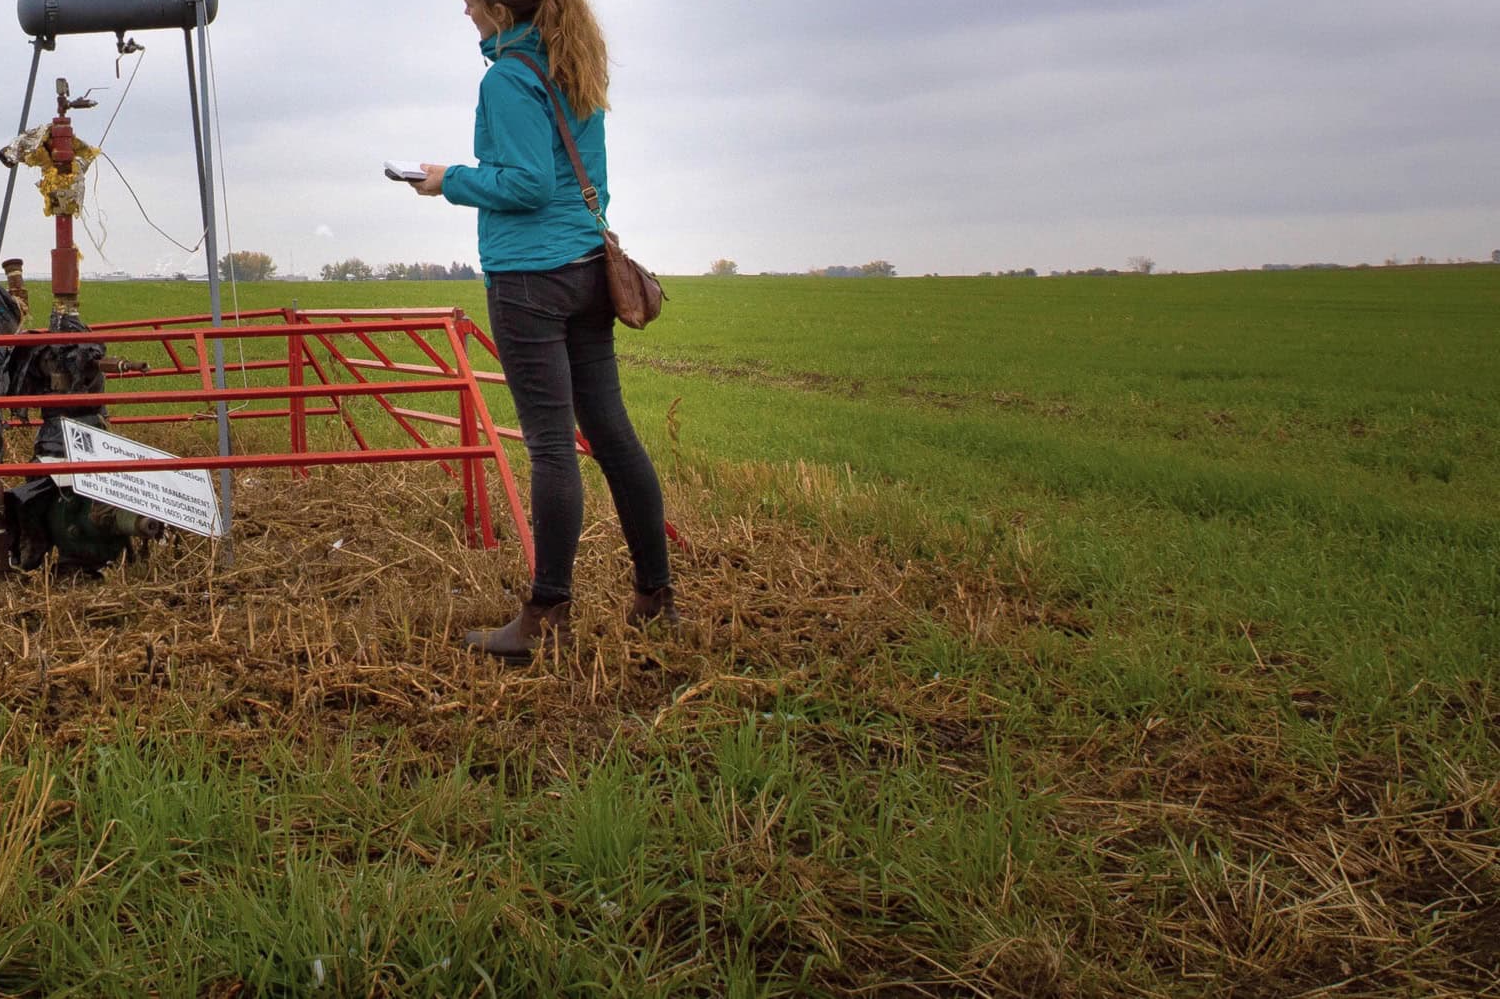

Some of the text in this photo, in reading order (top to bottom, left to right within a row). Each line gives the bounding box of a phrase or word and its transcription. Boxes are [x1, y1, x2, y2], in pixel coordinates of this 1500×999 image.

[102, 441, 136, 459] Orphan
[95, 474, 108, 483] THE
[110, 478, 140, 495] ORPHAN
[140, 489, 160, 502] WELL
[122, 472, 146, 486] UNDER
[146, 481, 160, 491] THE
[161, 486, 210, 509] MANAGEMENT
[81, 479, 99, 491] INFO
[105, 487, 148, 508] EMERGENCY
[164, 508, 182, 521] (403)
[183, 513, 211, 530] 297-641
